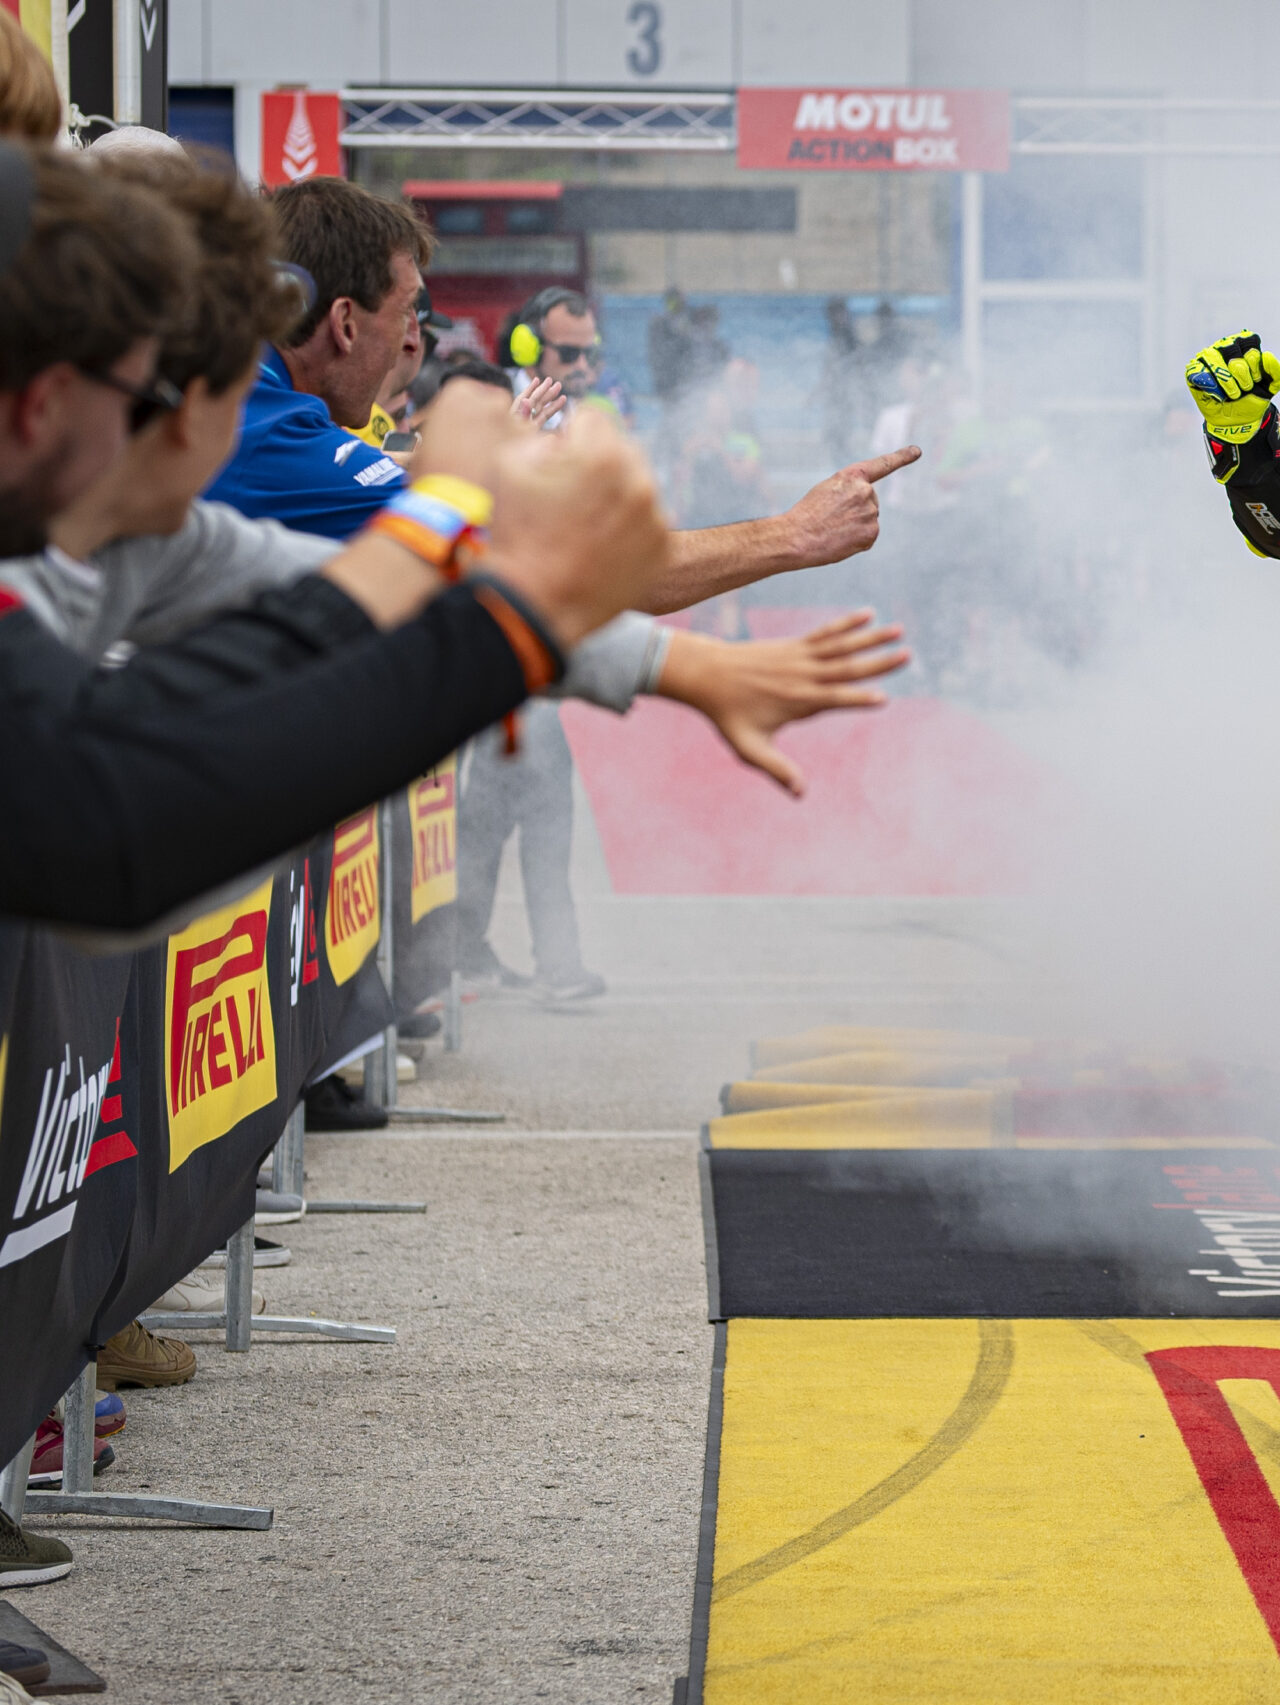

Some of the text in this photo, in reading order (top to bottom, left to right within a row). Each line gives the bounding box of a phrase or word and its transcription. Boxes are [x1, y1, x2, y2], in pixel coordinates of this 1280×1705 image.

[627, 3, 662, 75] 3
[793, 94, 950, 131] MOTUL
[170, 909, 268, 1119] PIRELLI
